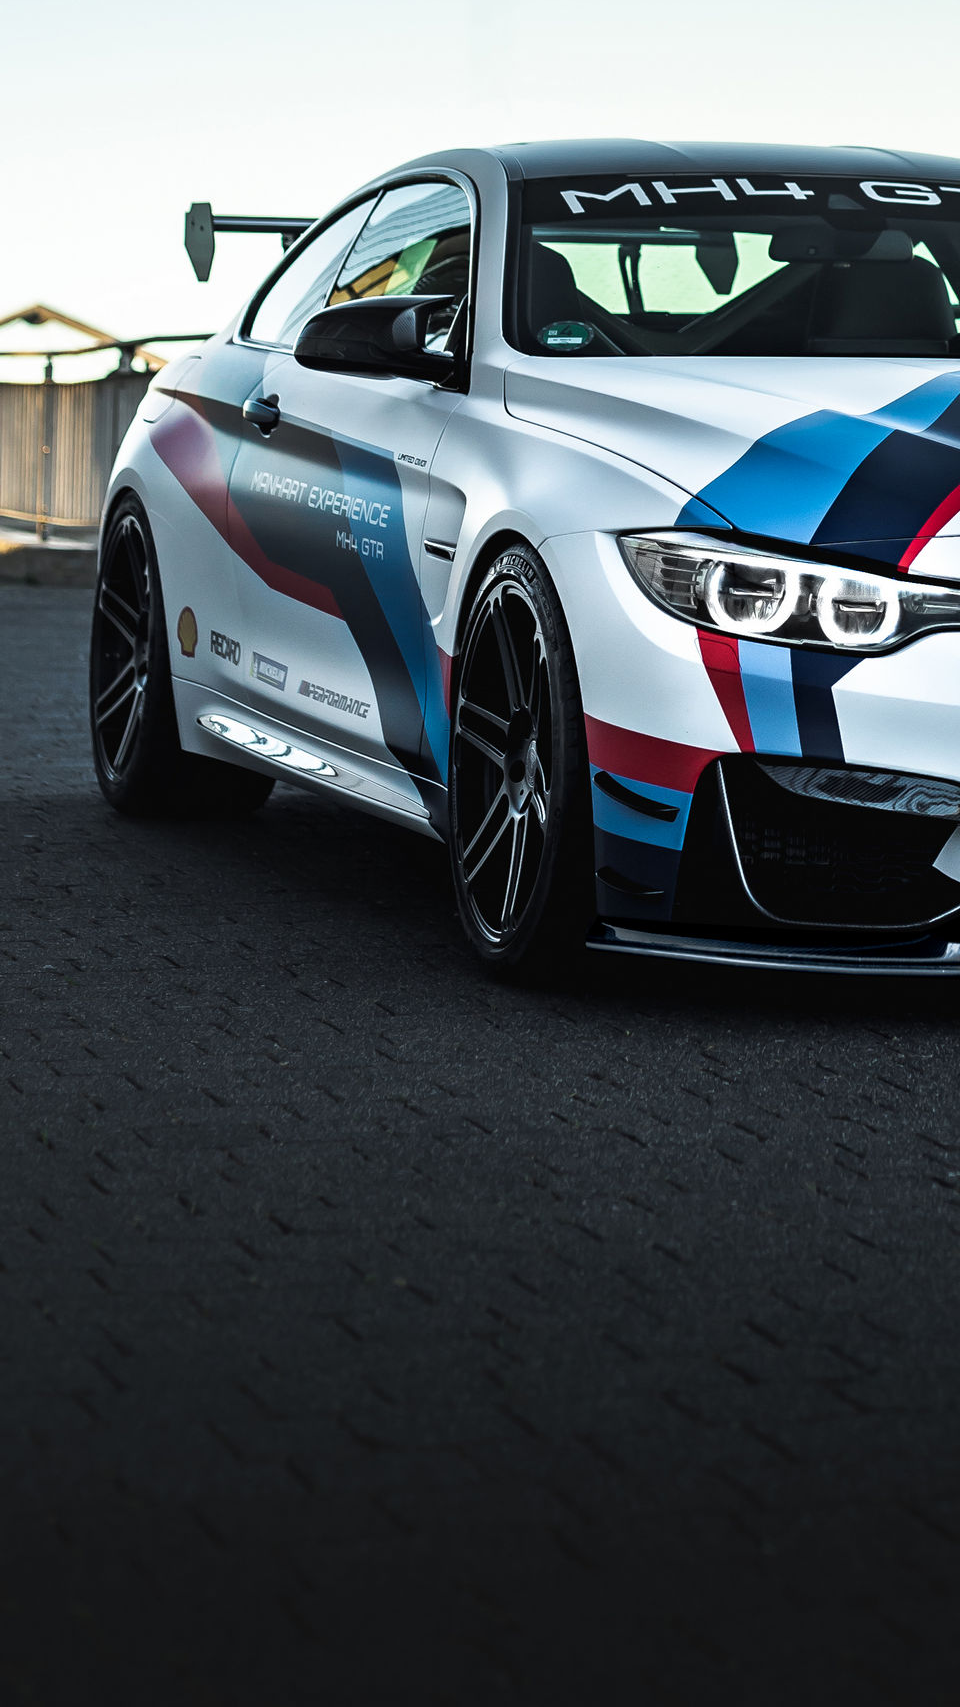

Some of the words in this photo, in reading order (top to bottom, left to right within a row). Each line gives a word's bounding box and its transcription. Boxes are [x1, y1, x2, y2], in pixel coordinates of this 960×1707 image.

[560, 178, 815, 213] MH4
[250, 470, 308, 503] MANHART
[307, 485, 391, 528] EXPERIENCE
[335, 530, 358, 553] MH4
[361, 537, 384, 560] GTR
[501, 555, 535, 580] MICHELIN
[210, 629, 241, 666] RECARO
